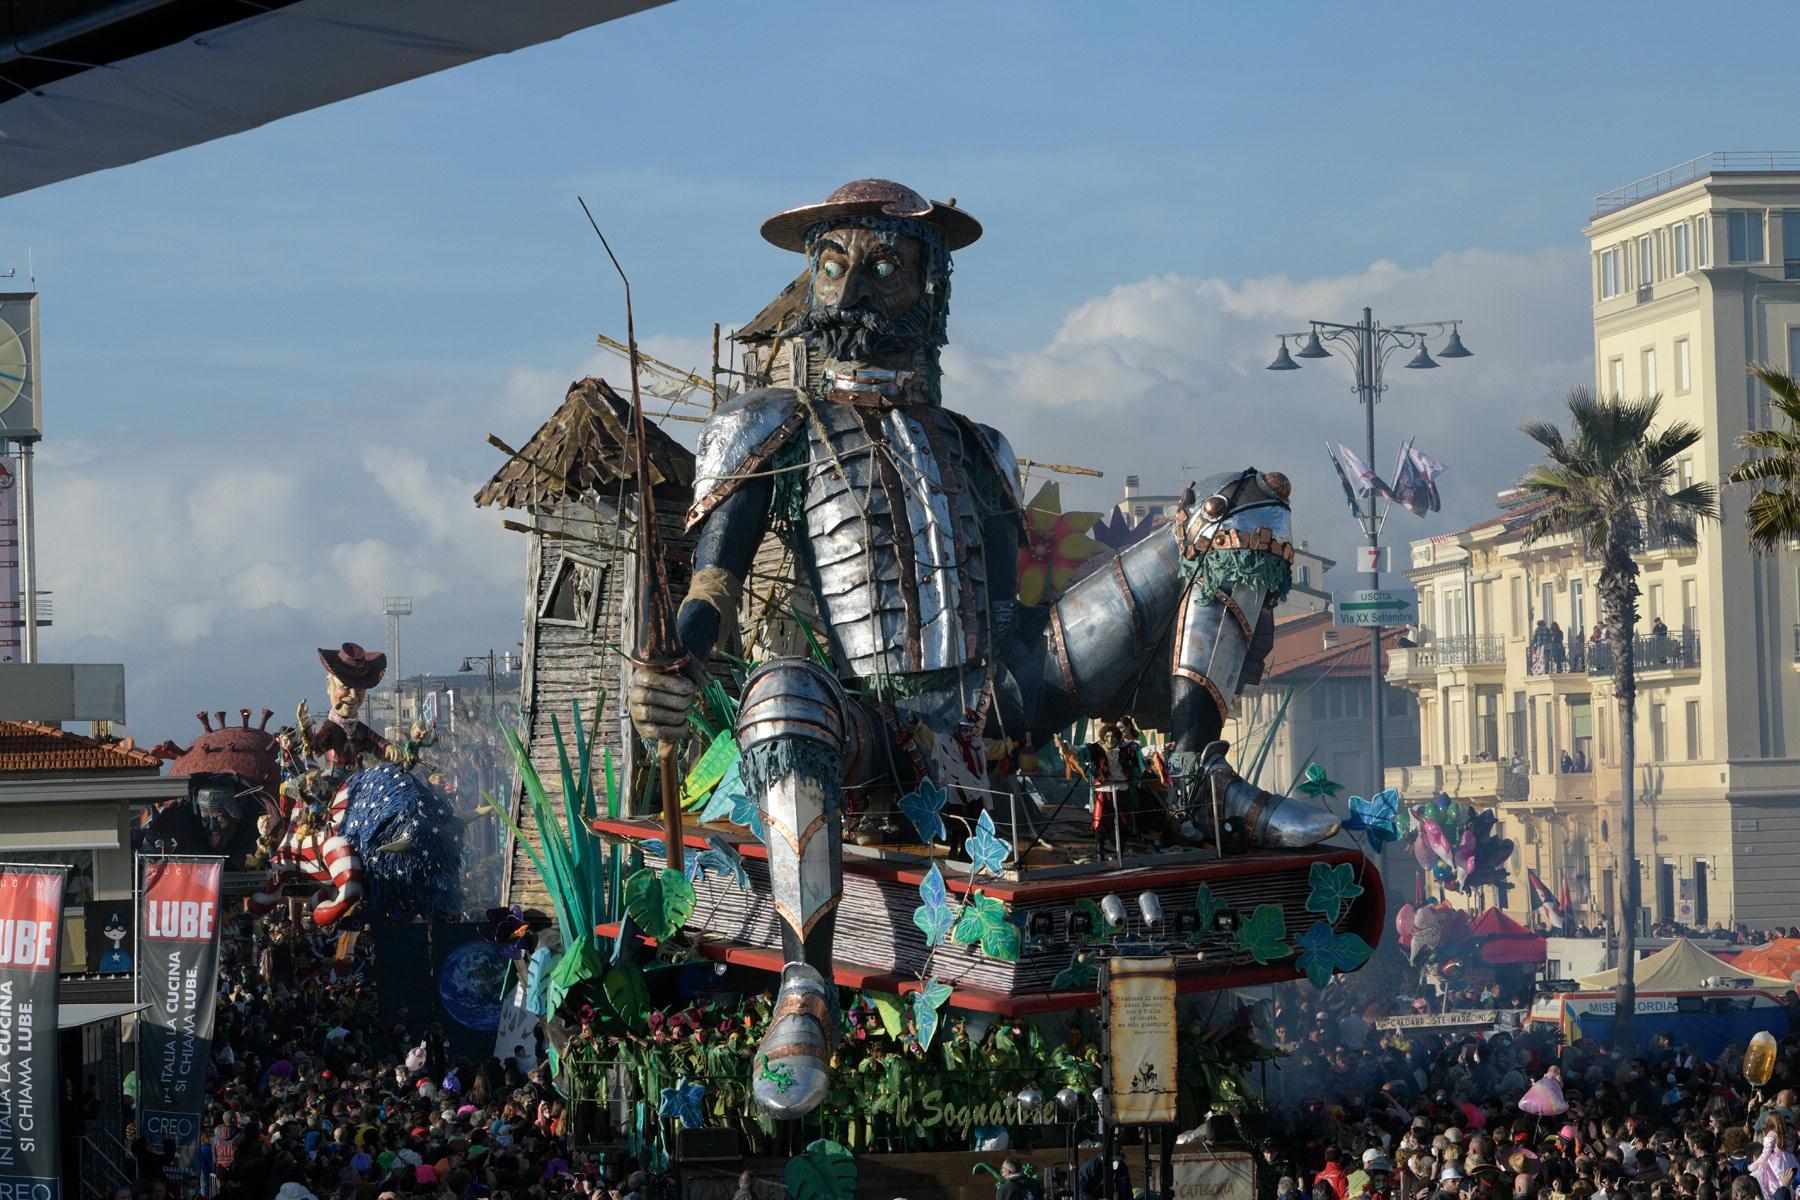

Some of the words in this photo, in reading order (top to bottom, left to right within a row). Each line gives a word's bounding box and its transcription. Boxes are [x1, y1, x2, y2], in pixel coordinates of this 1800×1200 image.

[1368, 550, 1380, 569] 7
[1361, 592, 1392, 601] USCITA
[1341, 613, 1354, 623] Via
[1356, 613, 1369, 623] XX
[1371, 612, 1414, 622] Settembre
[149, 900, 214, 938] LUBE
[0, 919, 52, 966] UBE
[166, 951, 181, 1013] CUCINA
[184, 966, 199, 1009] LUBE.
[0, 980, 13, 1056] CUCINA
[18, 999, 33, 1051] LUBE.
[166, 1017, 177, 1035] LA
[161, 1040, 176, 1082] ITALIA
[180, 1014, 196, 1076] CHIAMA
[0, 1062, 11, 1082] LA
[175, 1080, 188, 1092] SI
[18, 1057, 34, 1131] CHIAMA
[0, 1088, 12, 1139] ITALIA
[147, 1117, 192, 1136] CREO
[0, 1147, 14, 1165] IN
[20, 1138, 36, 1152] SI
